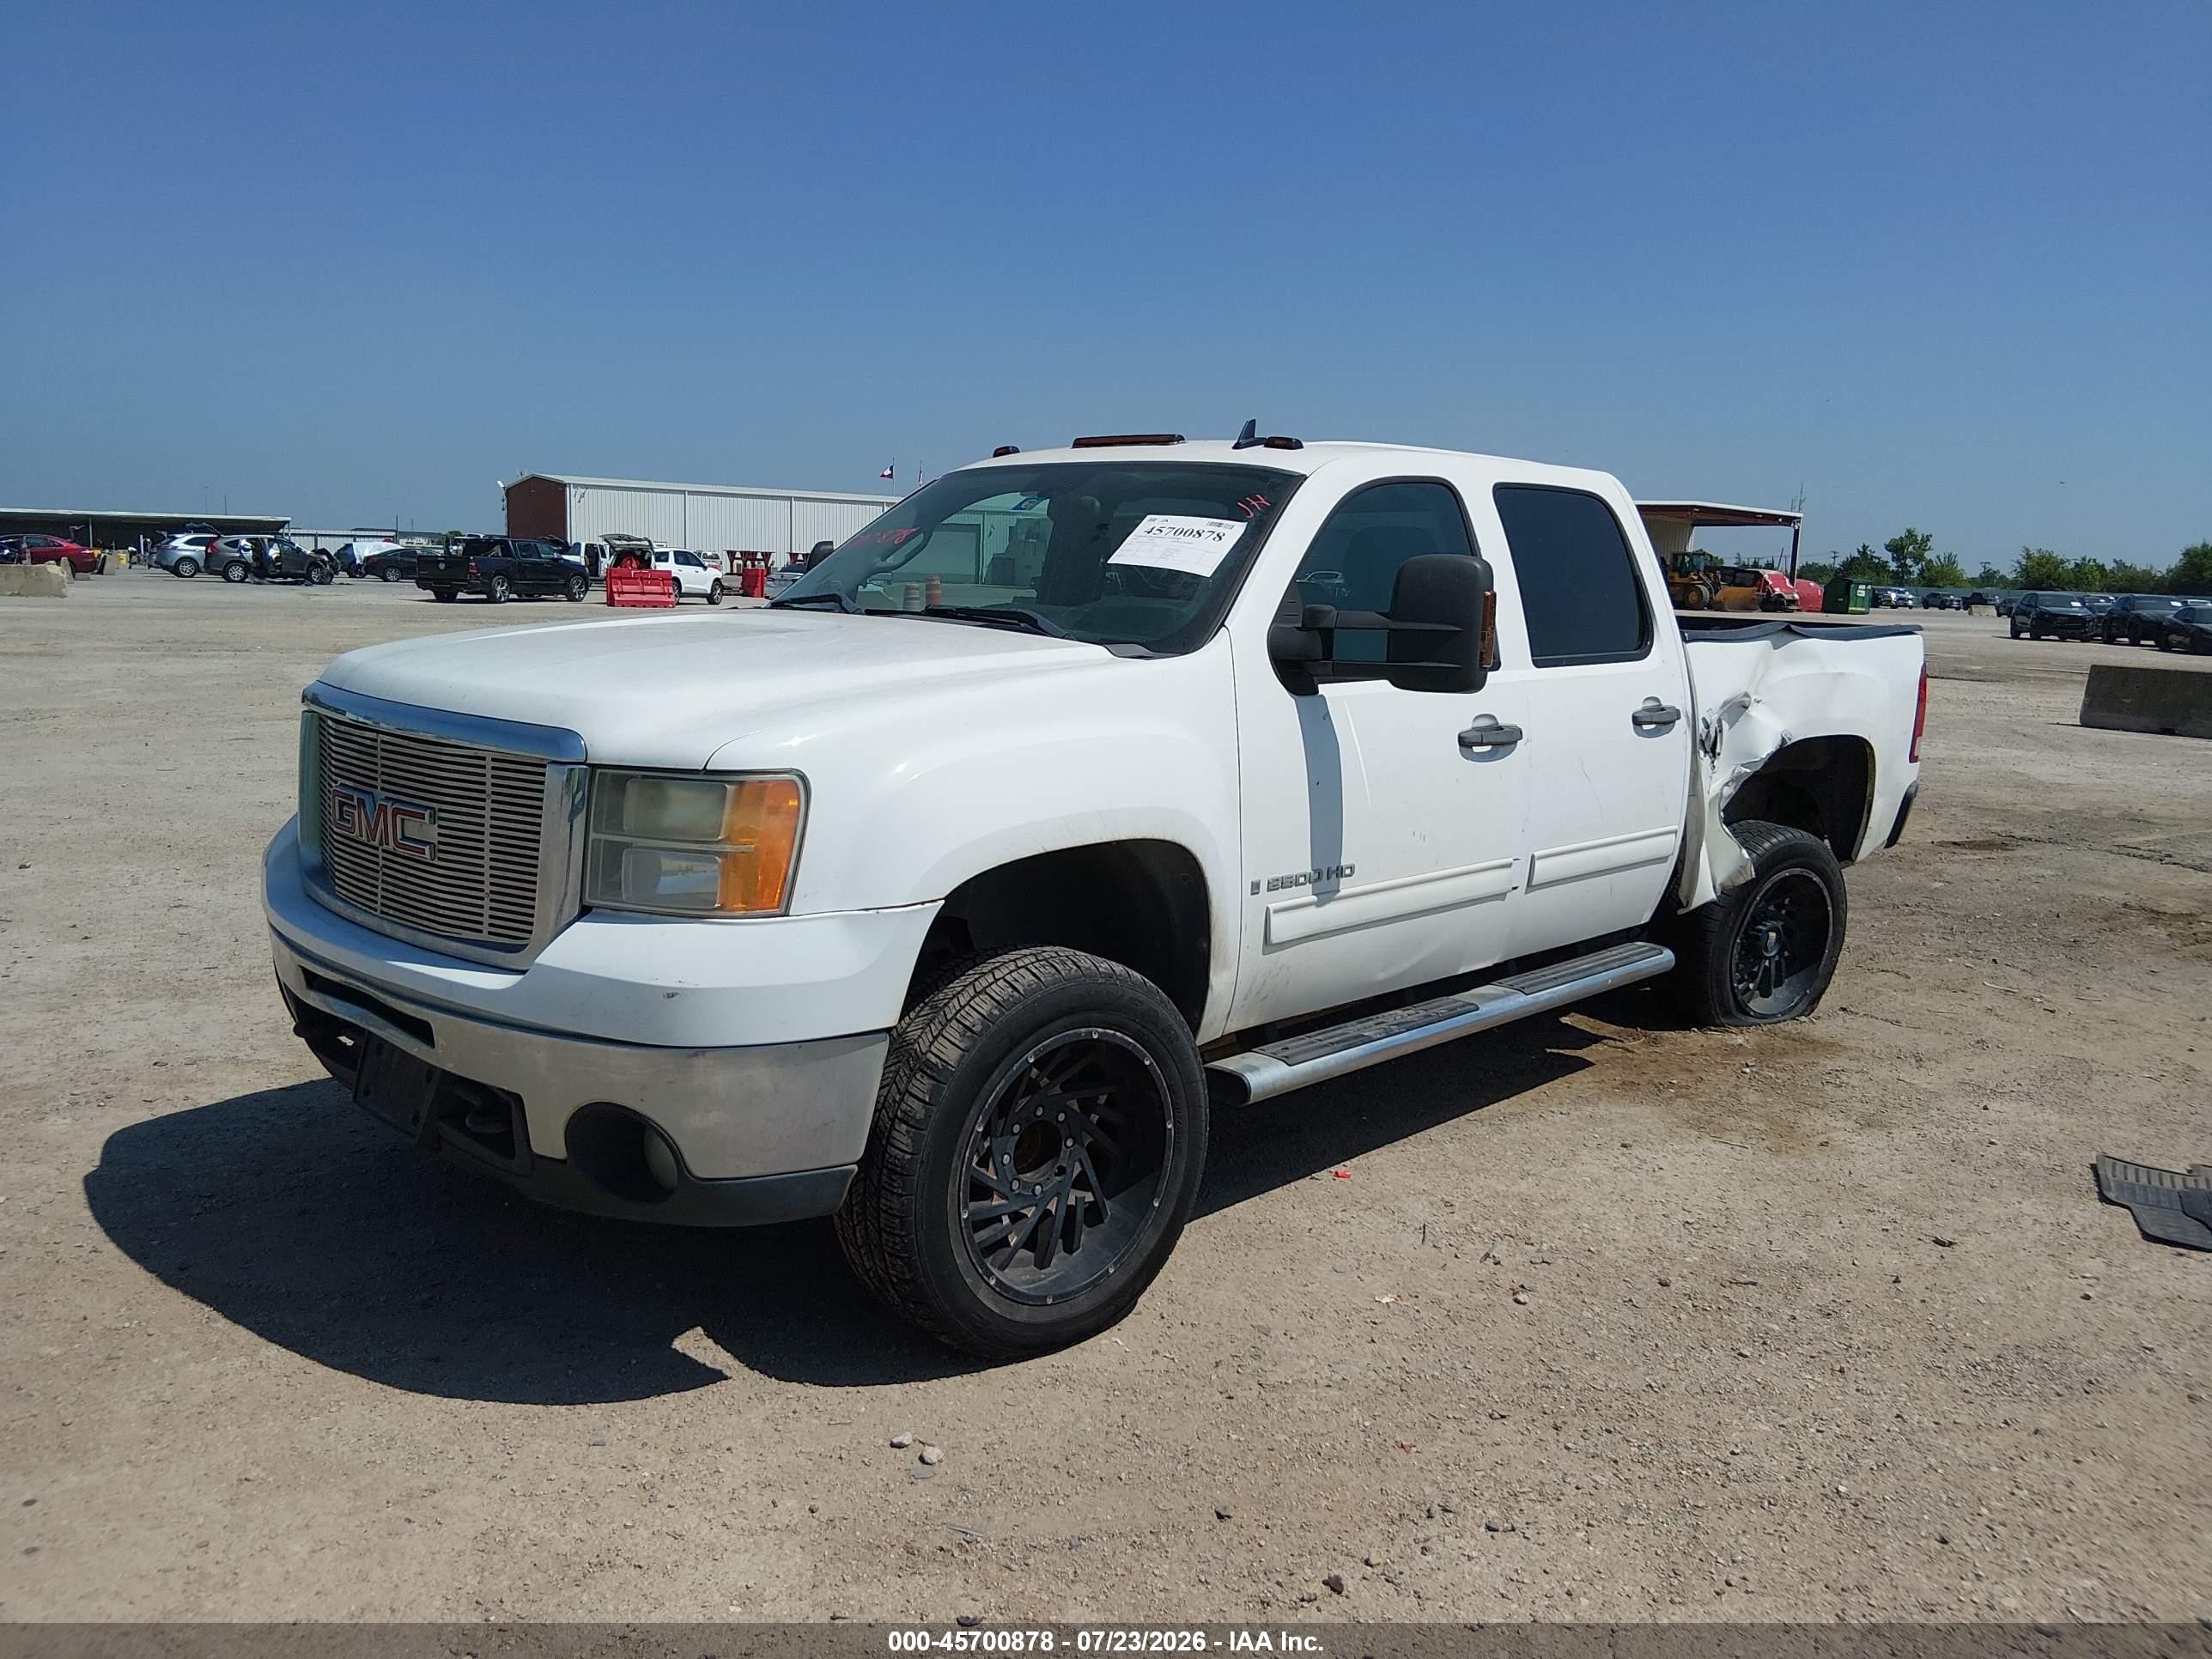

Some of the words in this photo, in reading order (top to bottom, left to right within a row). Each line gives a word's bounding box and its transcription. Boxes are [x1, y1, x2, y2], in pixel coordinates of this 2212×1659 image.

[1144, 526, 1226, 543] 45700878
[331, 784, 437, 861] GMC
[1327, 864, 1356, 880] HD
